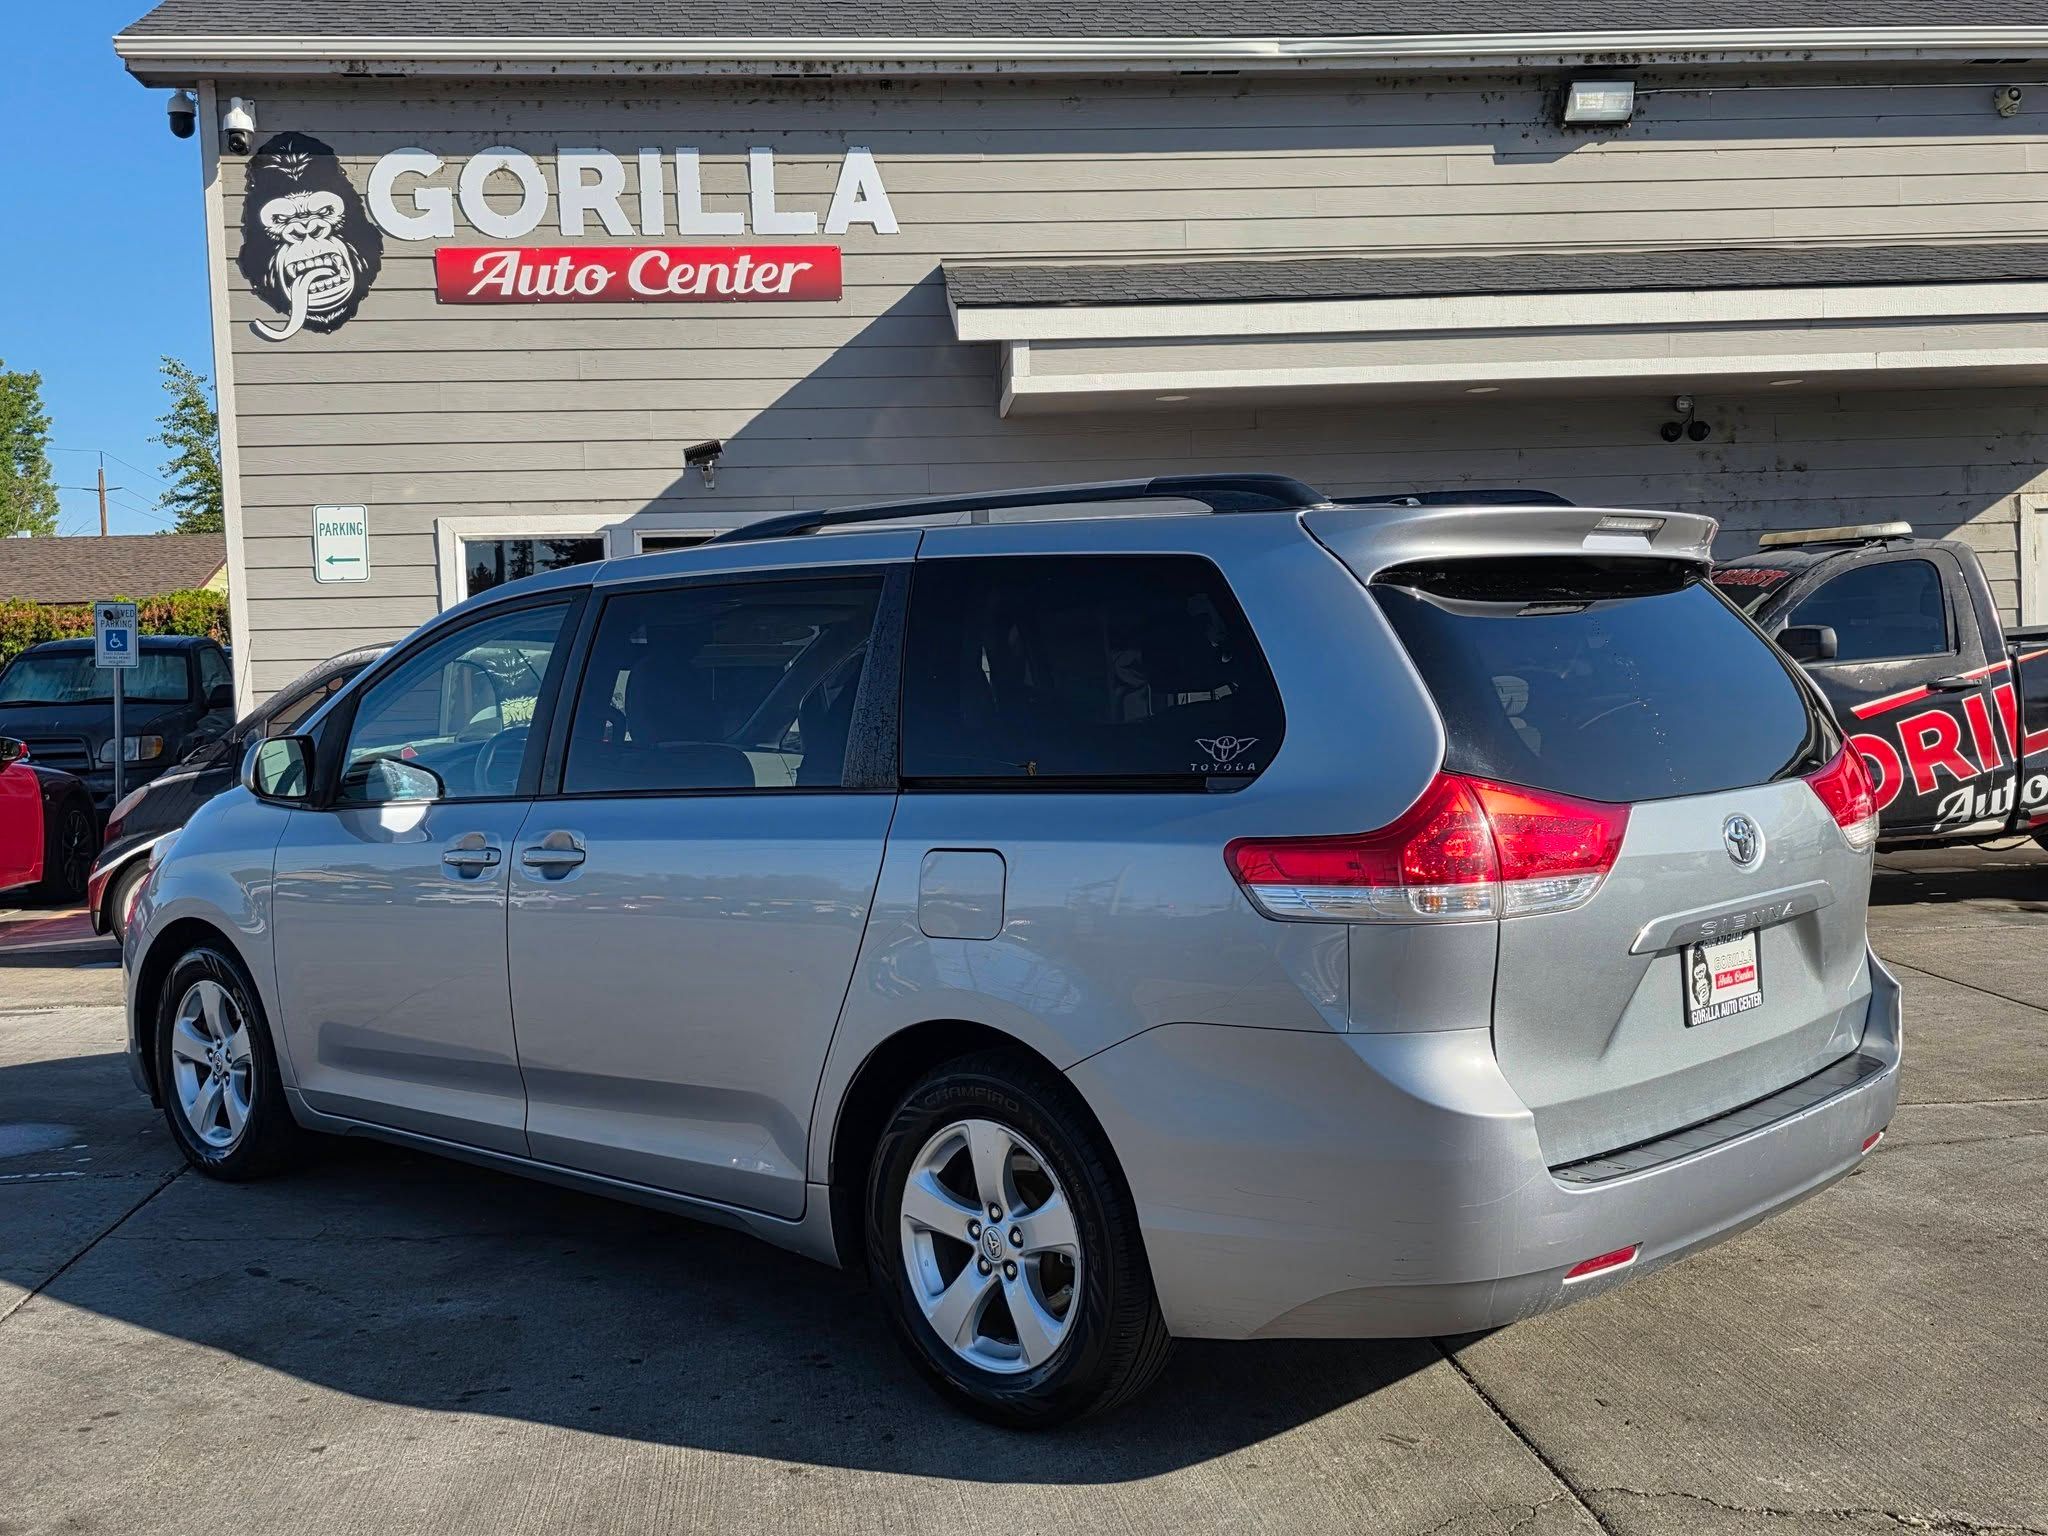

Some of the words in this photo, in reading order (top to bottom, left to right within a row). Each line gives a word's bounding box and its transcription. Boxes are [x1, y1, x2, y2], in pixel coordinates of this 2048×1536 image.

[368, 145, 900, 241] GORILLA
[467, 249, 616, 297] Auto
[627, 249, 813, 294] Center
[319, 521, 363, 537] PARKING
[97, 609, 135, 617] RVED
[100, 619, 133, 628] PARKING
[1933, 774, 2048, 832] Auto
[1701, 902, 1794, 935] SIENNA
[1713, 949, 1754, 970] GORILLA
[1717, 972, 1734, 987] Auto
[1735, 970, 1754, 984] Center
[1691, 1004, 1721, 1026] GORILLA
[1721, 998, 1738, 1017] AUTO
[1738, 991, 1762, 1012] CENTER
